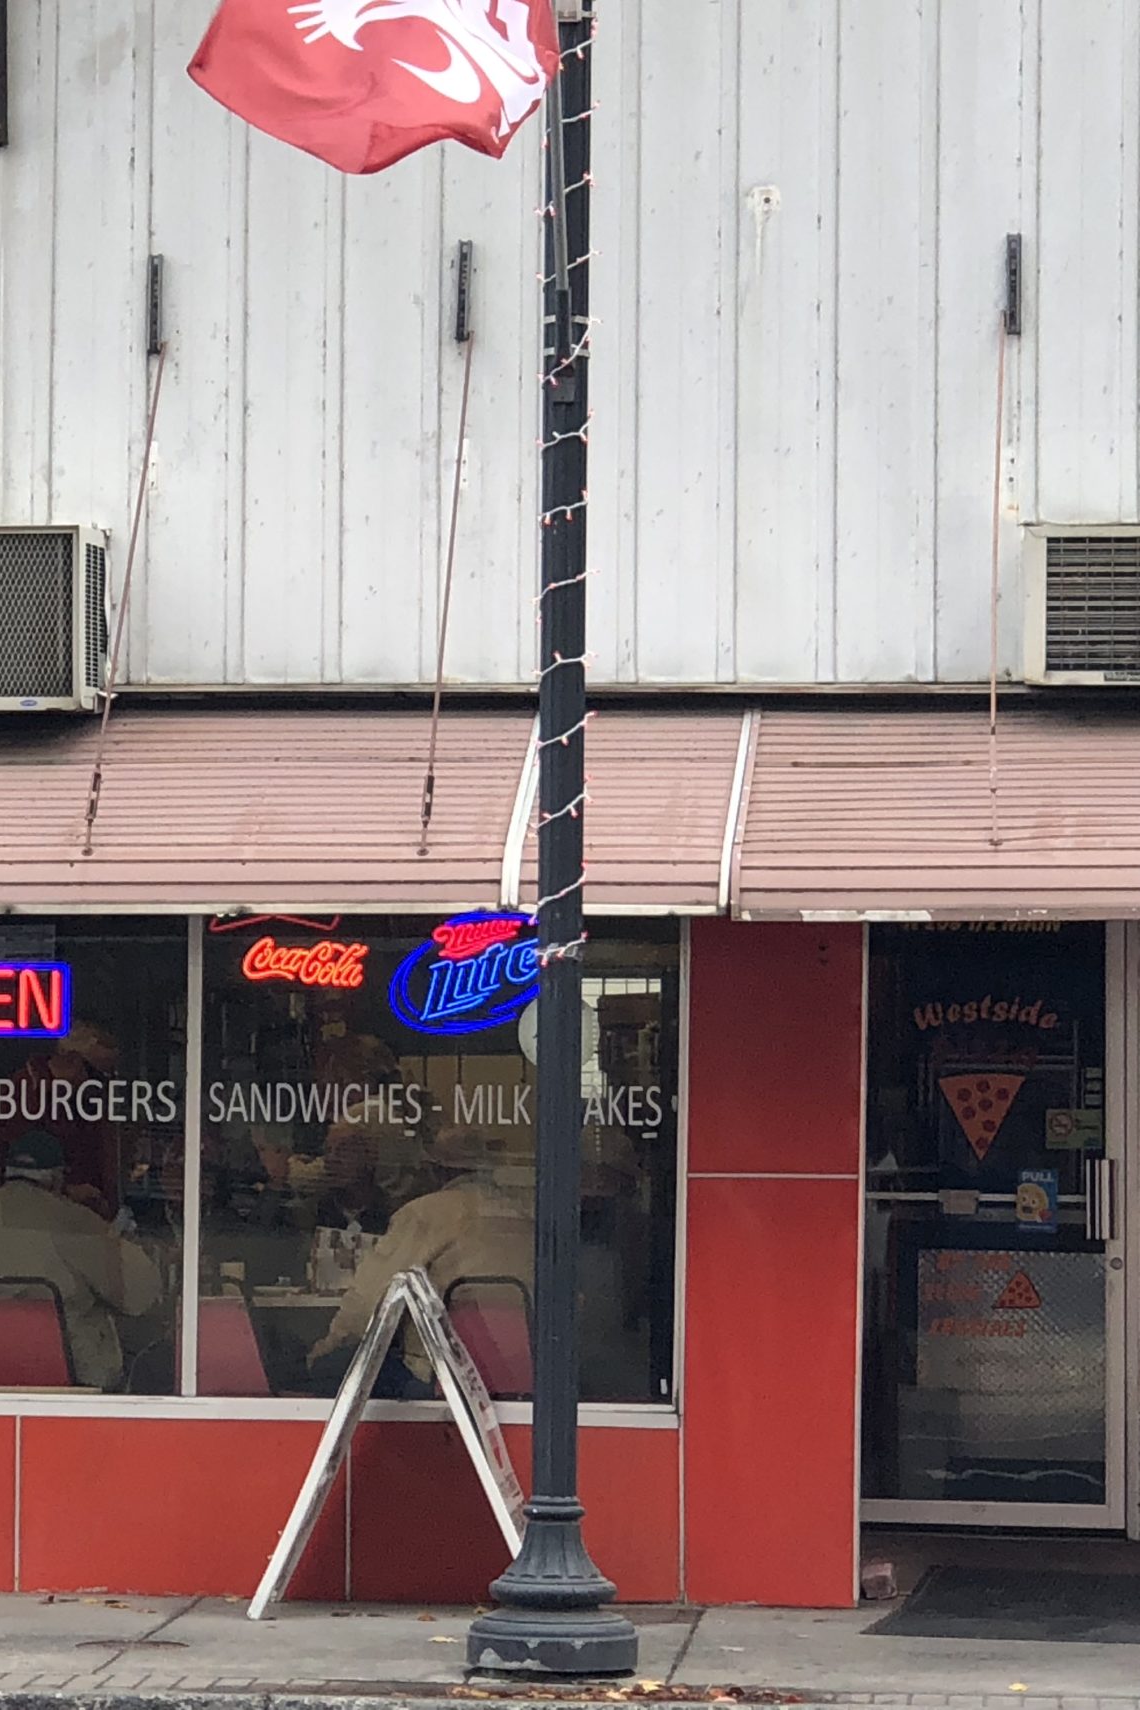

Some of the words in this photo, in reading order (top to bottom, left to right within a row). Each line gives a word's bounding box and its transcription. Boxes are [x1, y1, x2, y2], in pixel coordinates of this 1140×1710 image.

[432, 919, 522, 959] Miller
[420, 938, 540, 1021] Lite
[913, 994, 1059, 1031] Westside
[208, 1081, 422, 1125] SANDWICHES
[454, 1083, 663, 1127] MILKAKES
[1021, 1171, 1054, 1183] PULL
